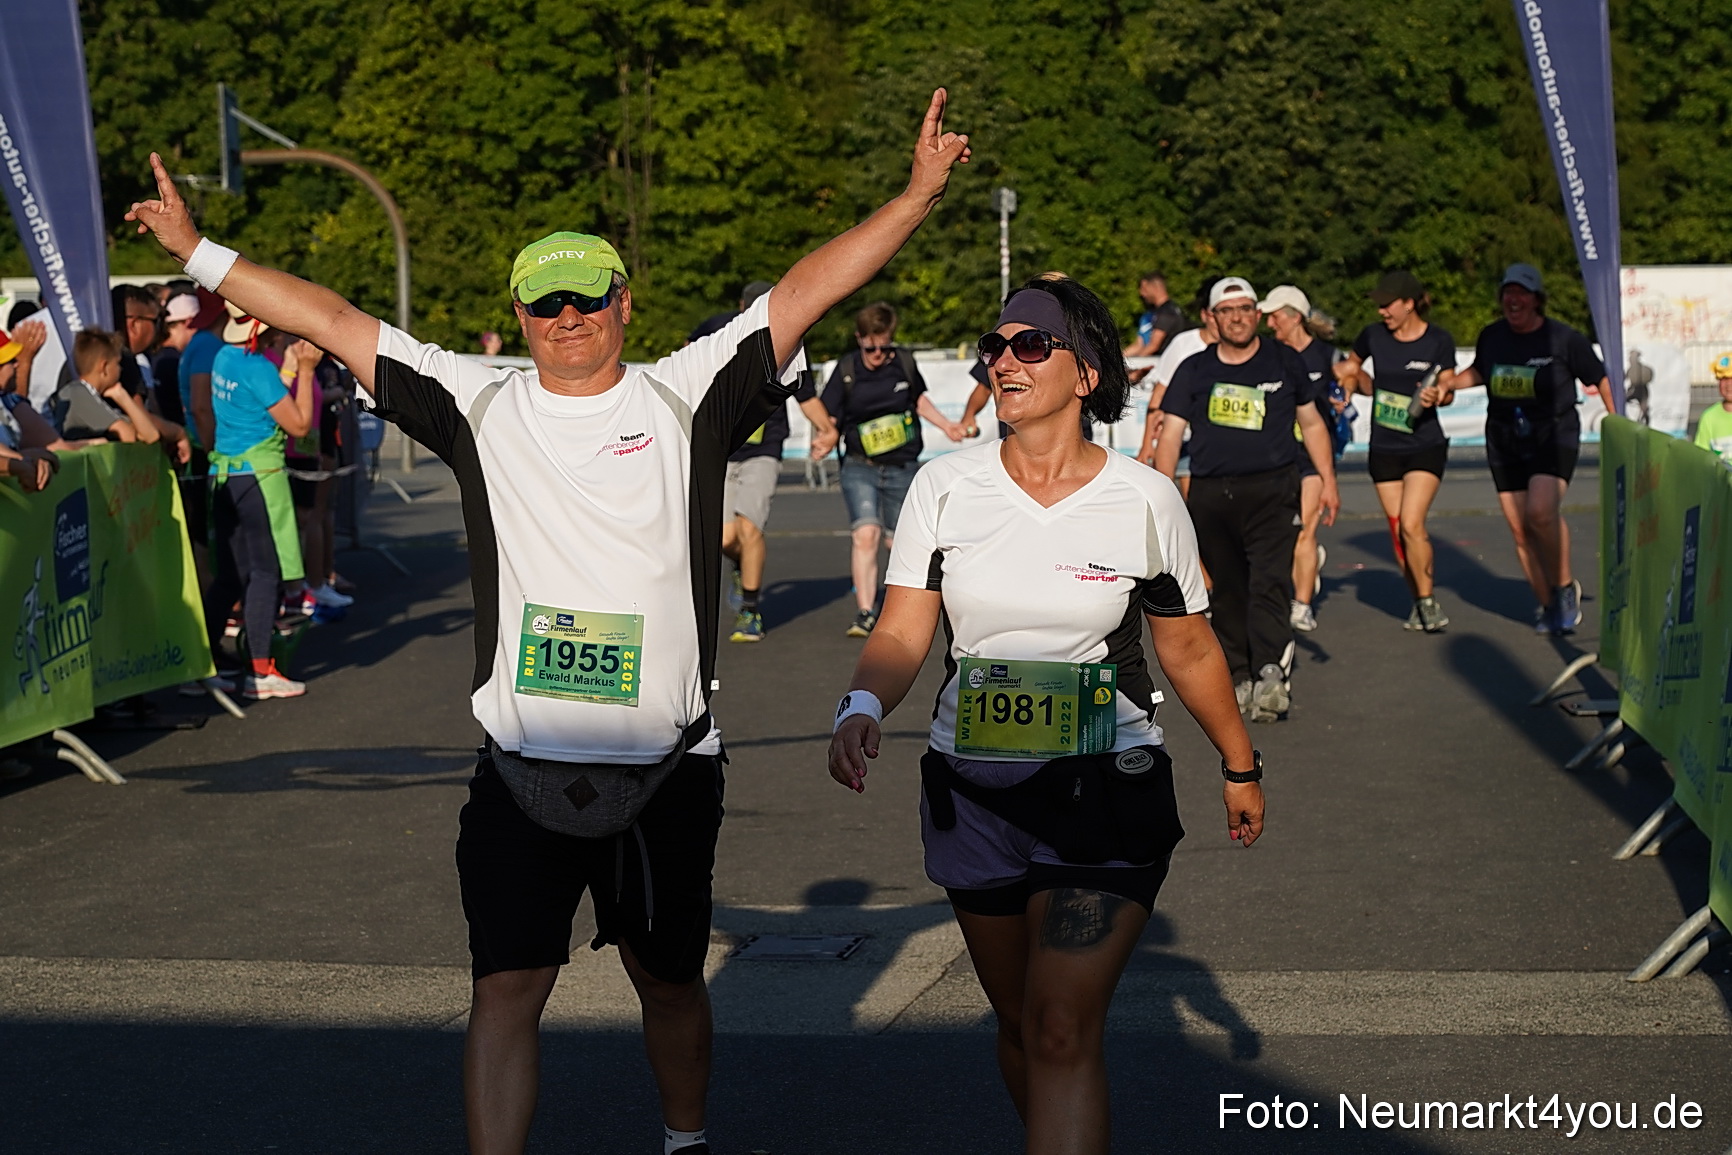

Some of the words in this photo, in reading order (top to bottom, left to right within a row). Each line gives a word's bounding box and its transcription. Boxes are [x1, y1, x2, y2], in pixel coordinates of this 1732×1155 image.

[539, 251, 585, 264] DATEV
[1222, 399, 1249, 413] 904
[620, 432, 645, 441] team
[1088, 563, 1116, 572] team
[550, 625, 587, 633] Firmenlauf
[524, 646, 536, 676] RUN
[539, 638, 620, 674] 1955
[538, 670, 570, 683] Ewald
[574, 674, 615, 687] Markus
[621, 651, 634, 692] 2022
[962, 695, 972, 740] WALK
[975, 692, 1052, 726] 1981
[1060, 702, 1071, 745] 2022
